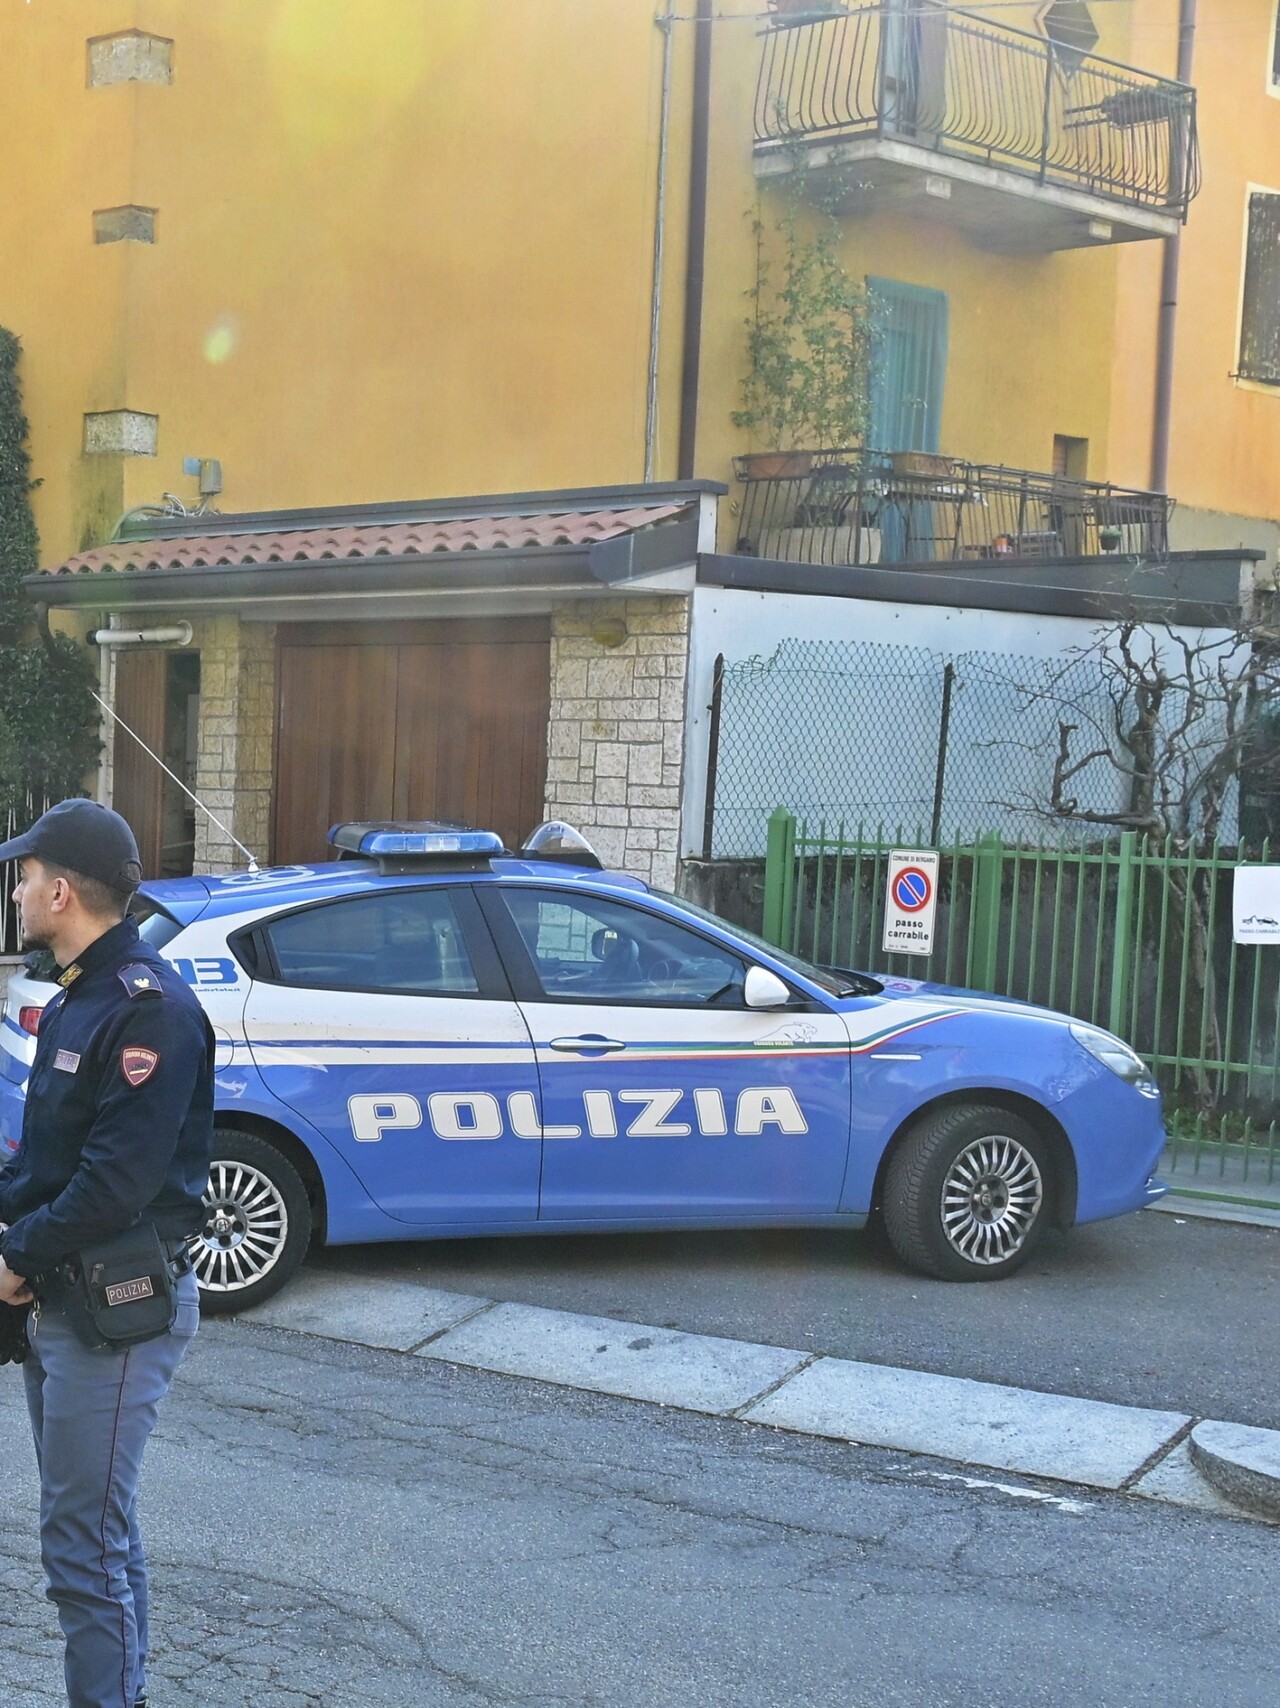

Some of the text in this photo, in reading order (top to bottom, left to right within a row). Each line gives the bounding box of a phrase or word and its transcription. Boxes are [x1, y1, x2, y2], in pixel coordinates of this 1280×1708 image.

[895, 919, 923, 928] passo
[888, 930, 929, 940] carrabile
[164, 958, 238, 984] 13
[348, 1086, 808, 1142] POLIZIA
[109, 1282, 149, 1300] POLIZIA
